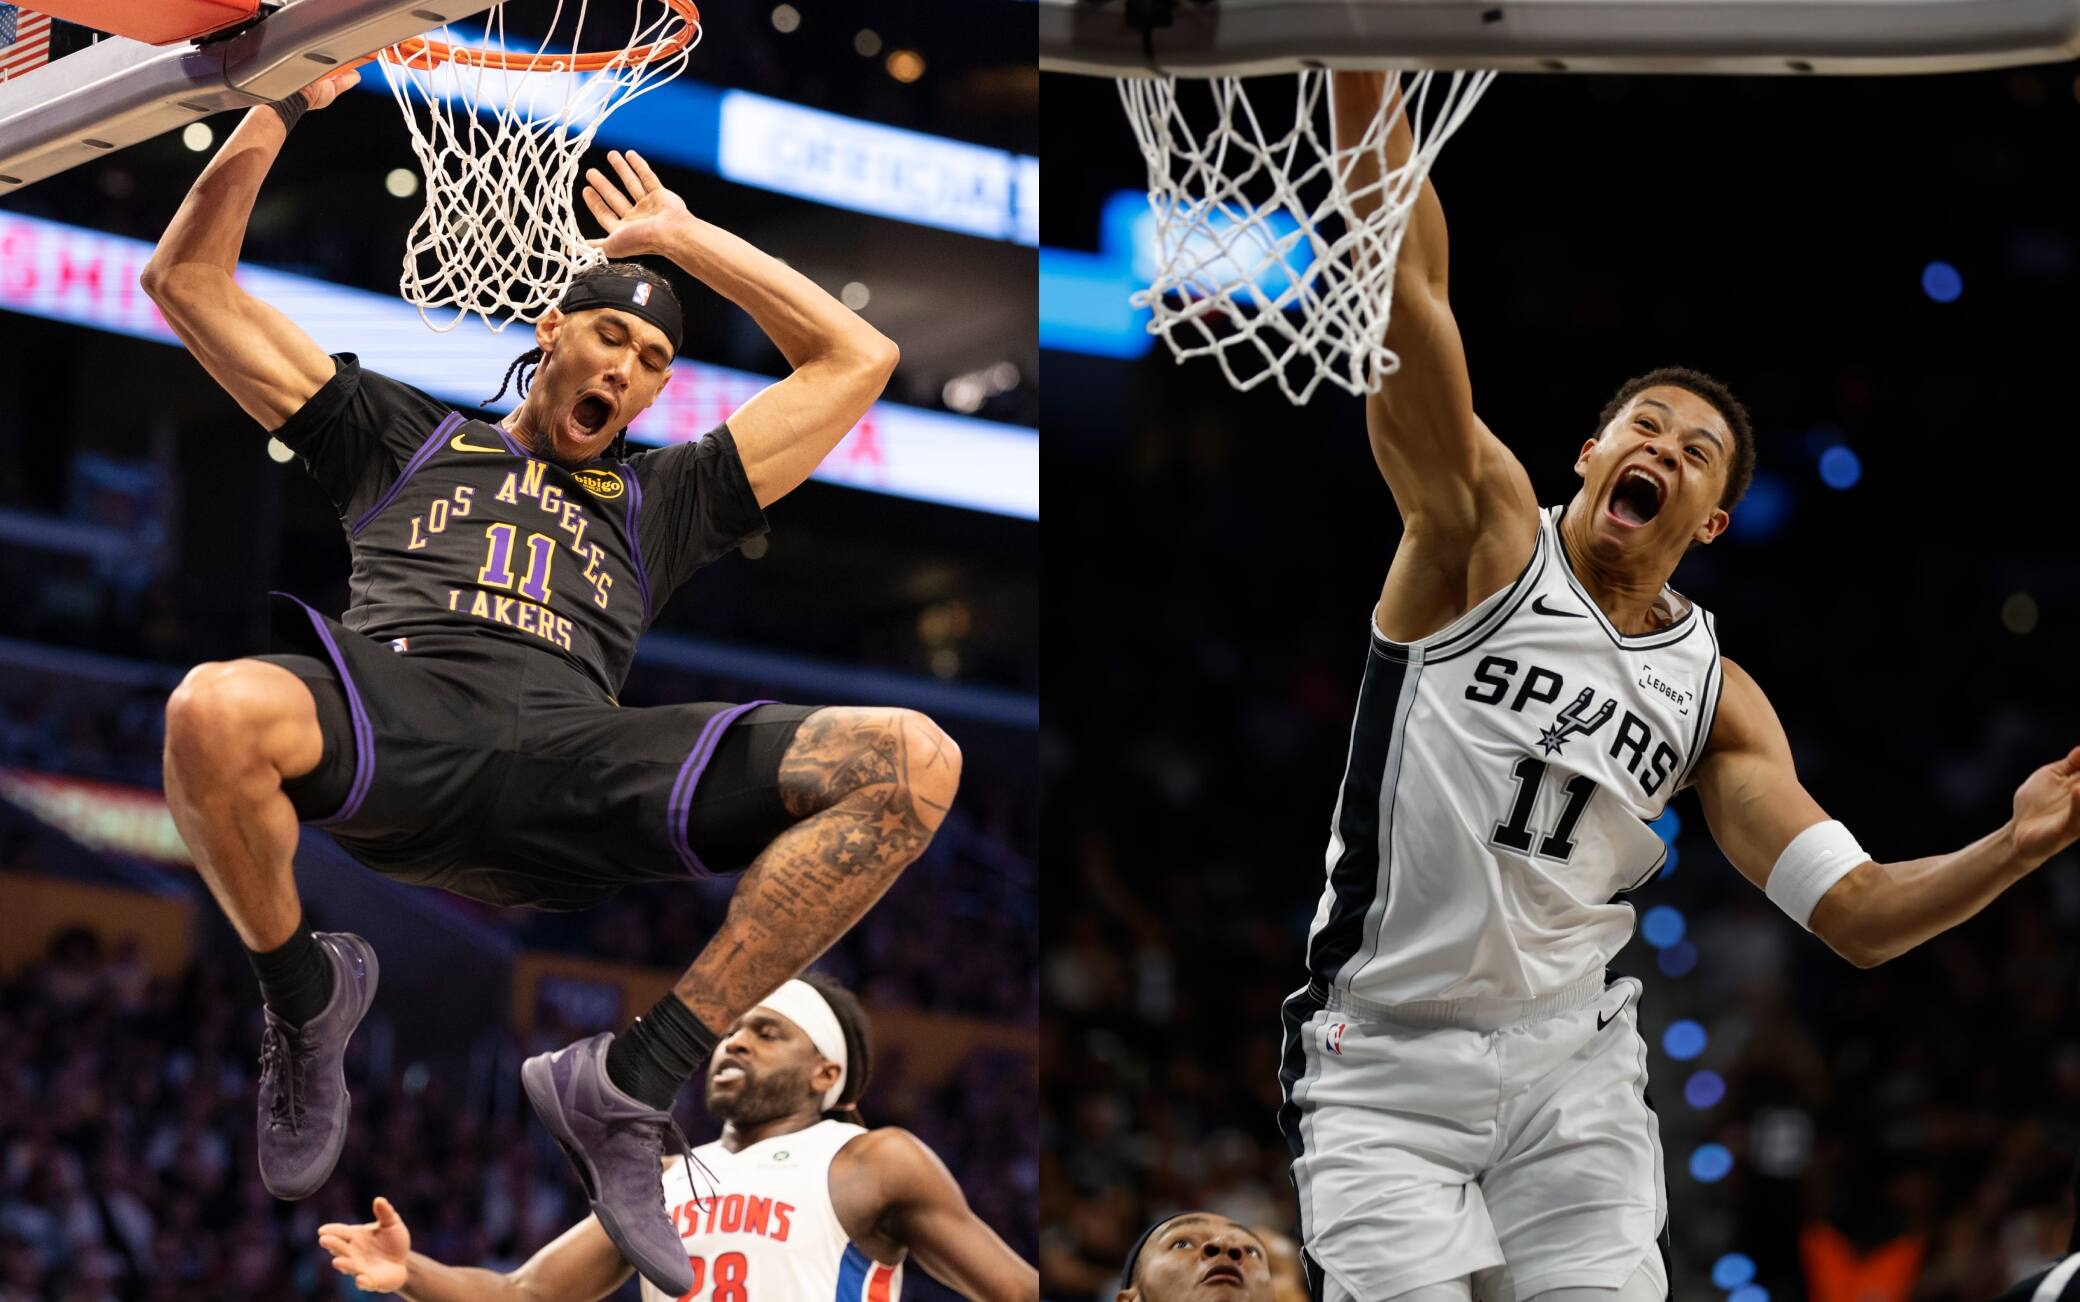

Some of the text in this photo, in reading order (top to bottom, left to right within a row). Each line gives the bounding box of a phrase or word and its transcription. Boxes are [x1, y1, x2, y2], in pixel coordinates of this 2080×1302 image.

[574, 474, 621, 492] bibigo
[407, 458, 614, 610] LOS ANGELES
[476, 522, 557, 605] 11
[448, 588, 573, 652] LAKERS
[1645, 673, 1686, 707] LEDGER
[1487, 754, 1602, 867] 11
[669, 1193, 796, 1243] ISTONS
